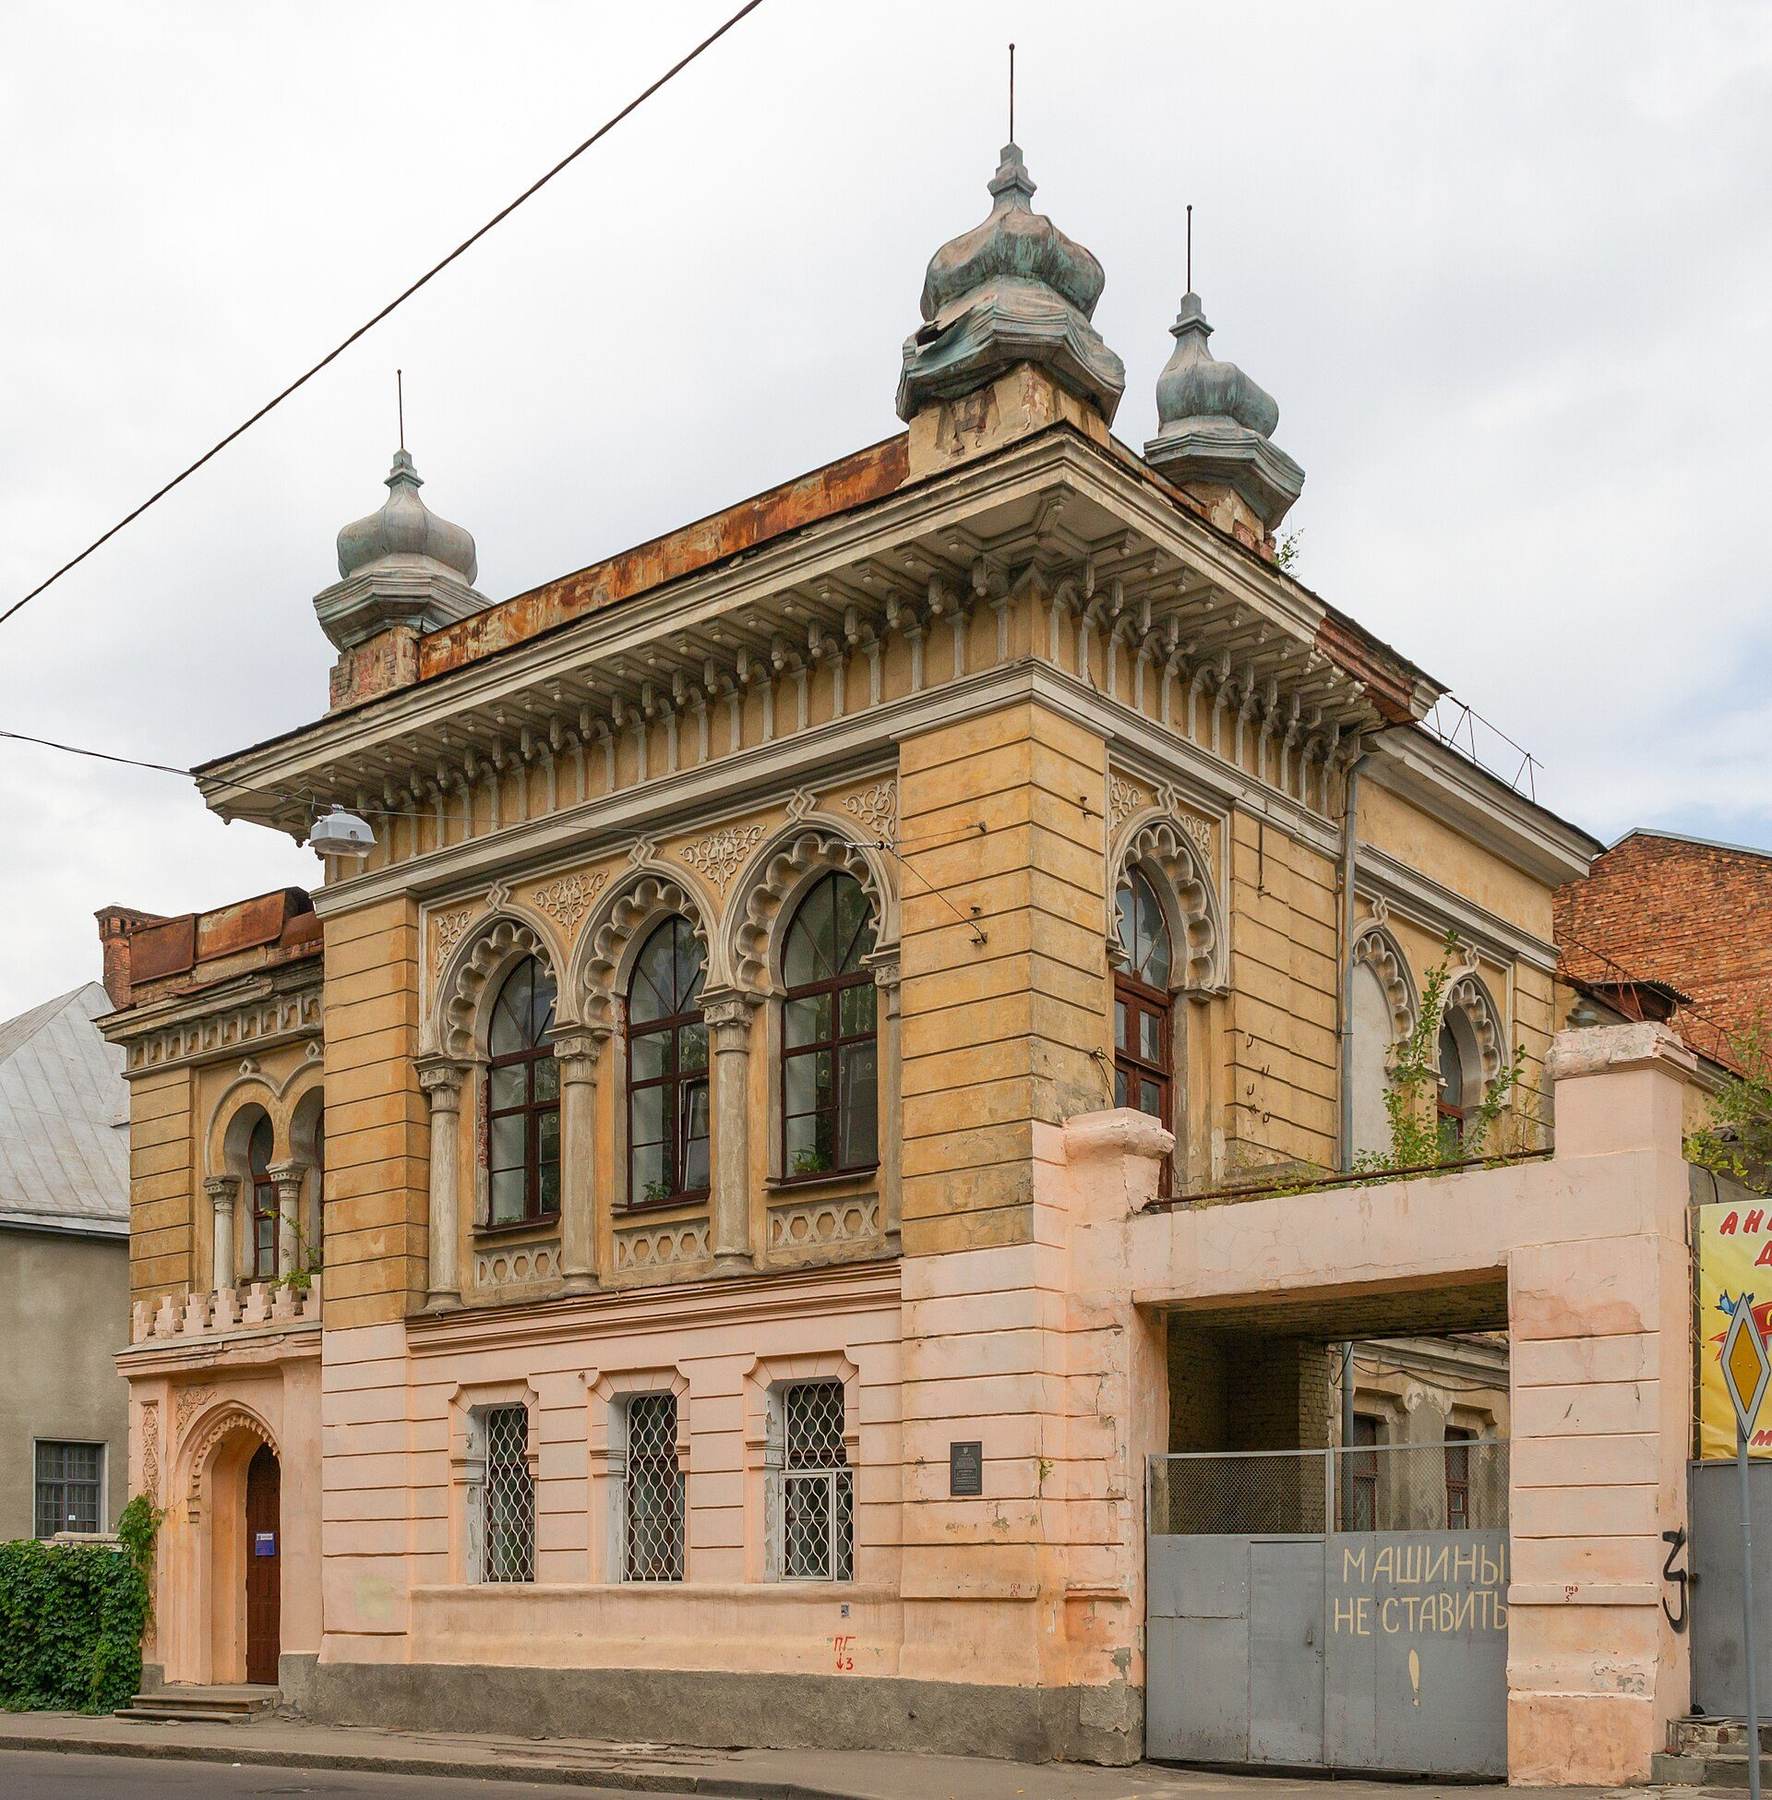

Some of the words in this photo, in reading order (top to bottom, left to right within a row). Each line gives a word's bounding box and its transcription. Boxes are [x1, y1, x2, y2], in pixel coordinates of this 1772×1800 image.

[1343, 1543, 1505, 1585] МАШИНЫ
[1333, 1597, 1372, 1636] НЕ
[1381, 1590, 1508, 1634] СТАВИТЬ
[845, 1657, 854, 1671] 3
